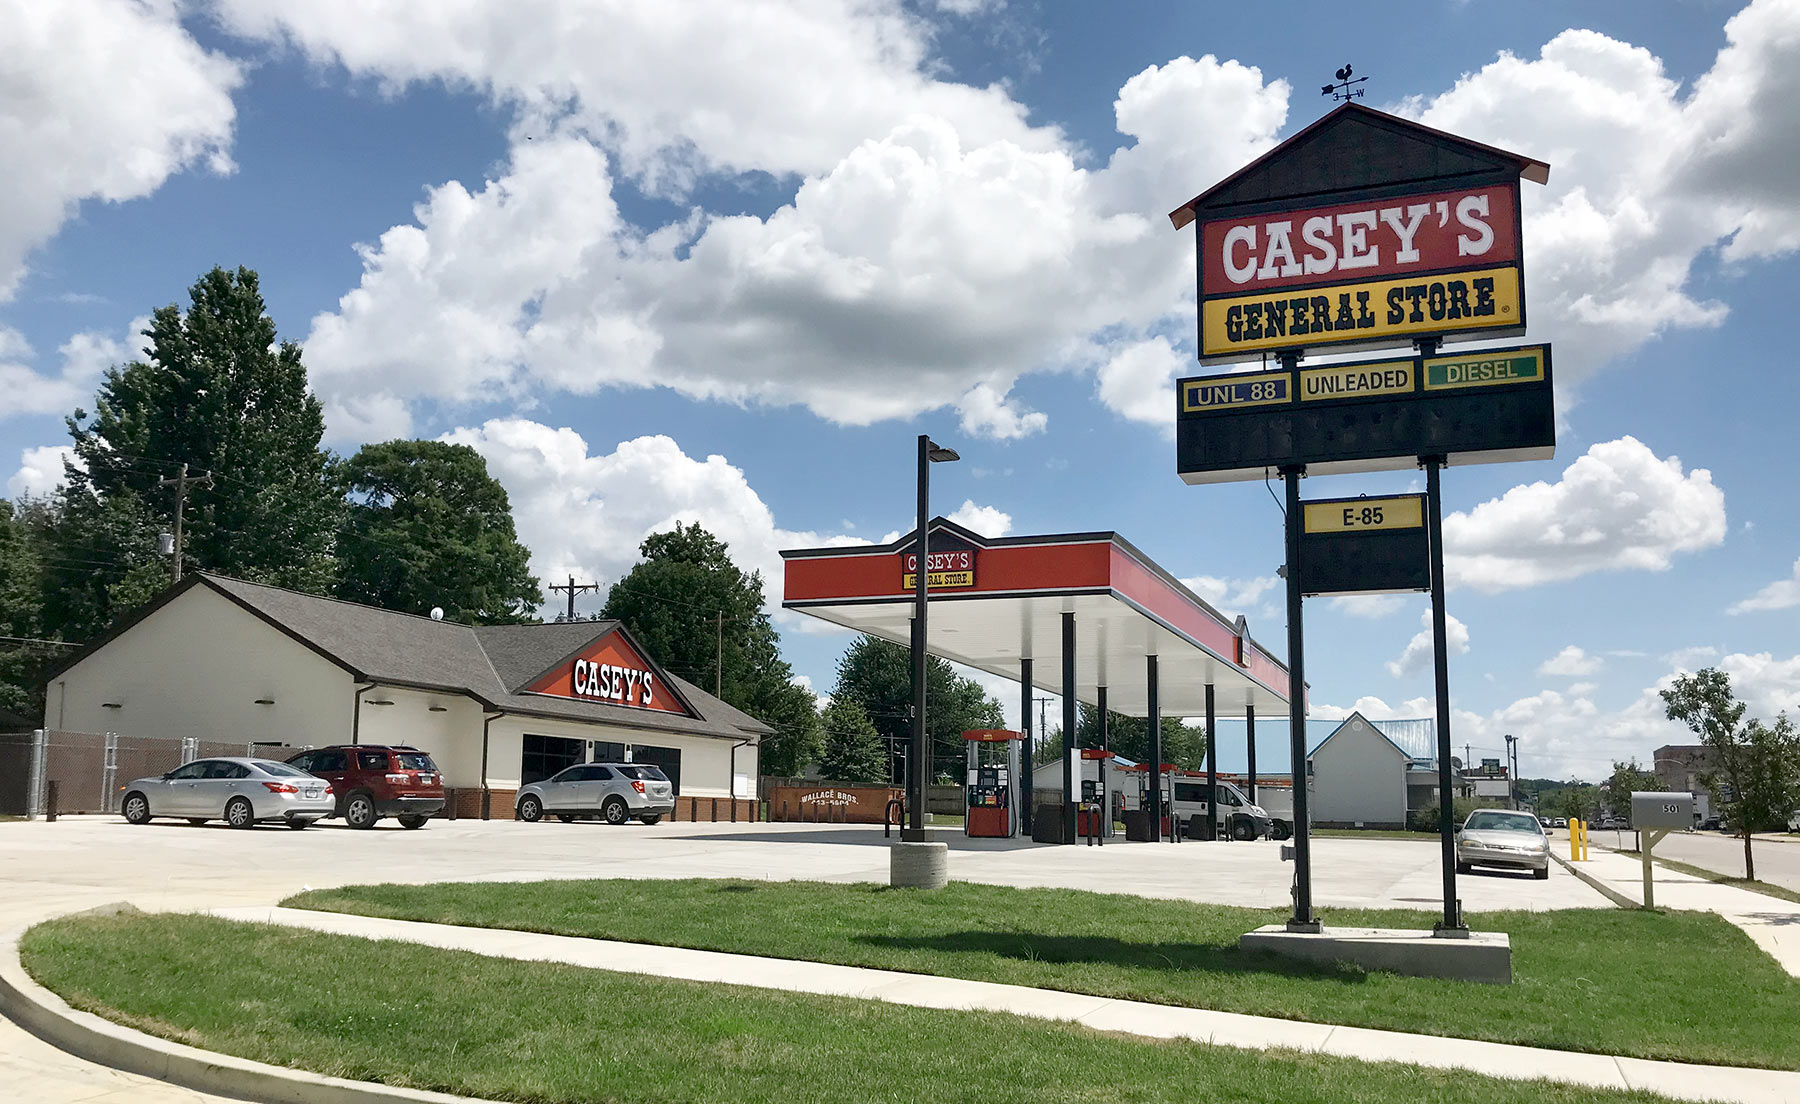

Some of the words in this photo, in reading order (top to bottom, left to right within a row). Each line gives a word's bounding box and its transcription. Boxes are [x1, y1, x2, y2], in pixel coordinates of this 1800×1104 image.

[1222, 194, 1495, 284] CASEY'S
[1225, 291, 1376, 343] GENERAL
[1387, 277, 1496, 326] STORE
[1306, 369, 1409, 395] UNLEADED
[1446, 359, 1518, 383] DIESEL
[1196, 386, 1245, 406] UNL
[1250, 381, 1277, 400] 88
[1342, 506, 1385, 526] E-85
[908, 552, 969, 571] CSEY'S
[910, 575, 942, 586] GERAL
[945, 574, 967, 585] STORE
[574, 658, 653, 705] CASEY'S
[801, 790, 834, 803] WALLACE
[837, 791, 859, 805] BROS.
[1663, 804, 1680, 813] 501
